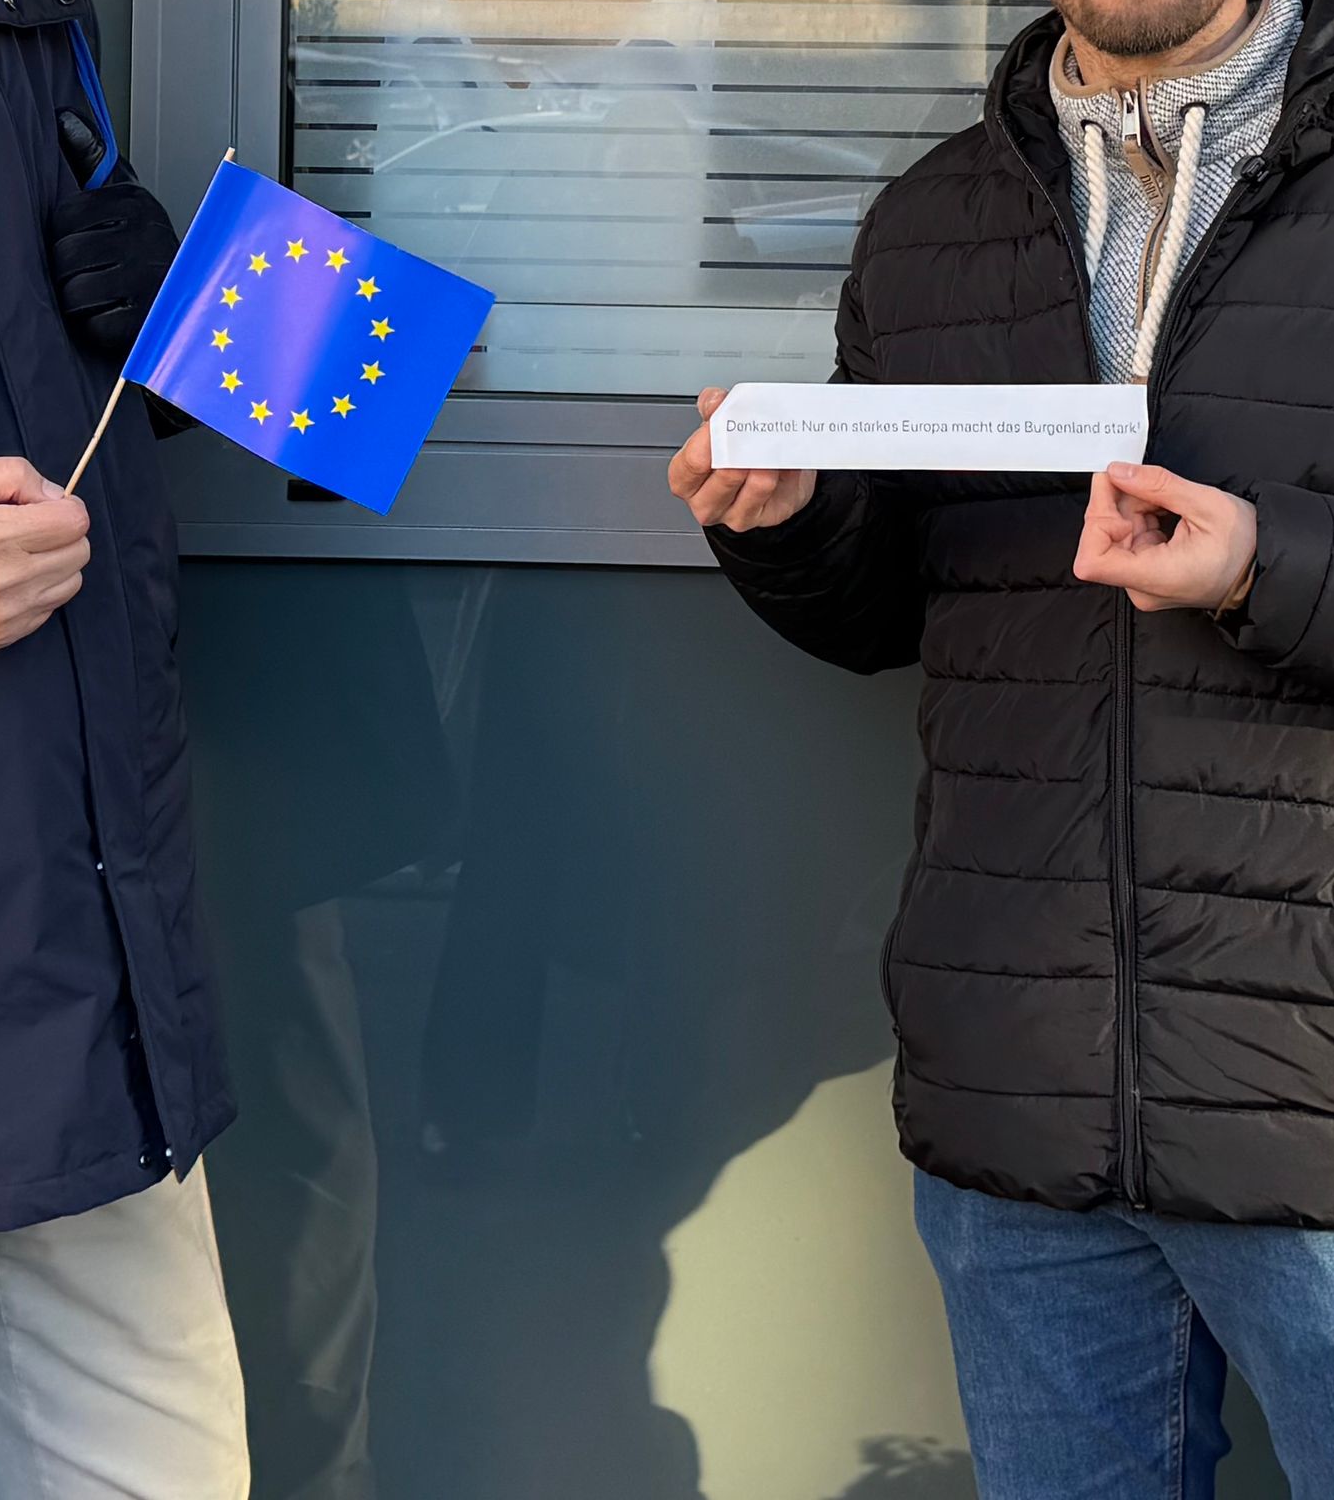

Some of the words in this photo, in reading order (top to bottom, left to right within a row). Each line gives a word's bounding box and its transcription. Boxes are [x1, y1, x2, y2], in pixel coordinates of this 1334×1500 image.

[725, 419, 798, 433] Denkzettel:
[801, 419, 826, 433] Nur
[828, 419, 848, 433] ein
[851, 419, 899, 433] starkes
[901, 419, 948, 435] Europa
[951, 420, 993, 433] macht
[996, 420, 1021, 434] das
[1024, 420, 1100, 436] Burgenland
